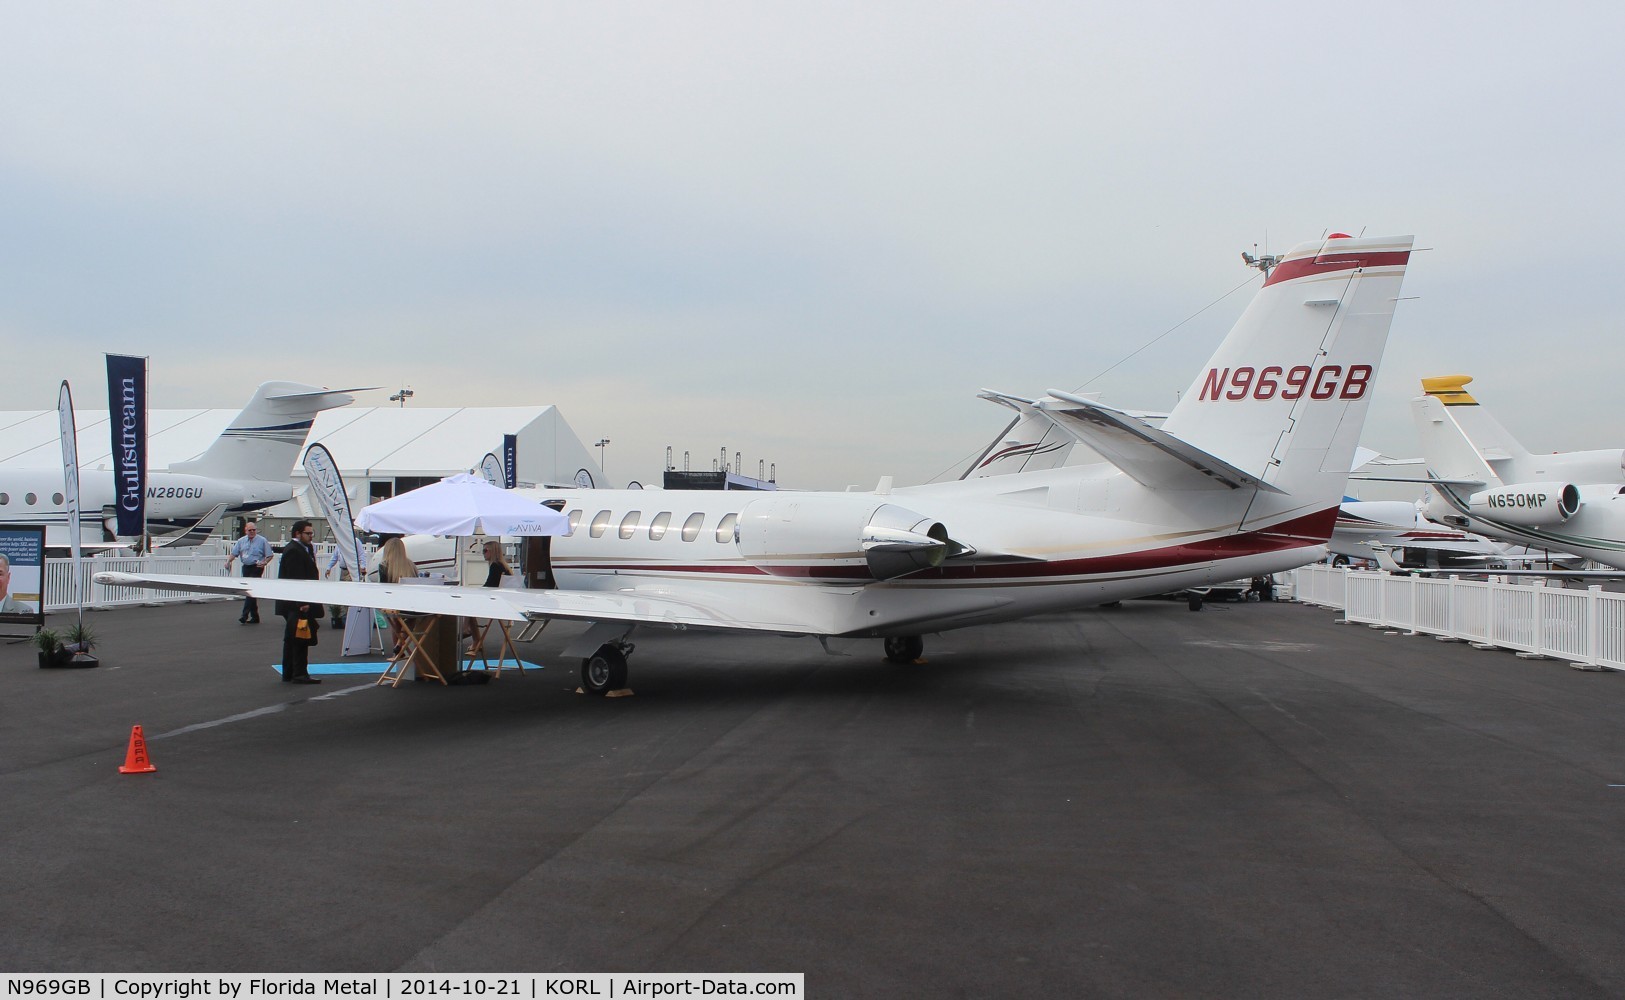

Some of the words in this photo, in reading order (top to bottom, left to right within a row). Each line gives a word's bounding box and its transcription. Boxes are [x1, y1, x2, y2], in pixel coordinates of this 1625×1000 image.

[1198, 364, 1373, 401] N969GB
[121, 376, 140, 512] Gulfstream
[147, 487, 203, 498] N280GU
[1488, 493, 1547, 508] N650MP
